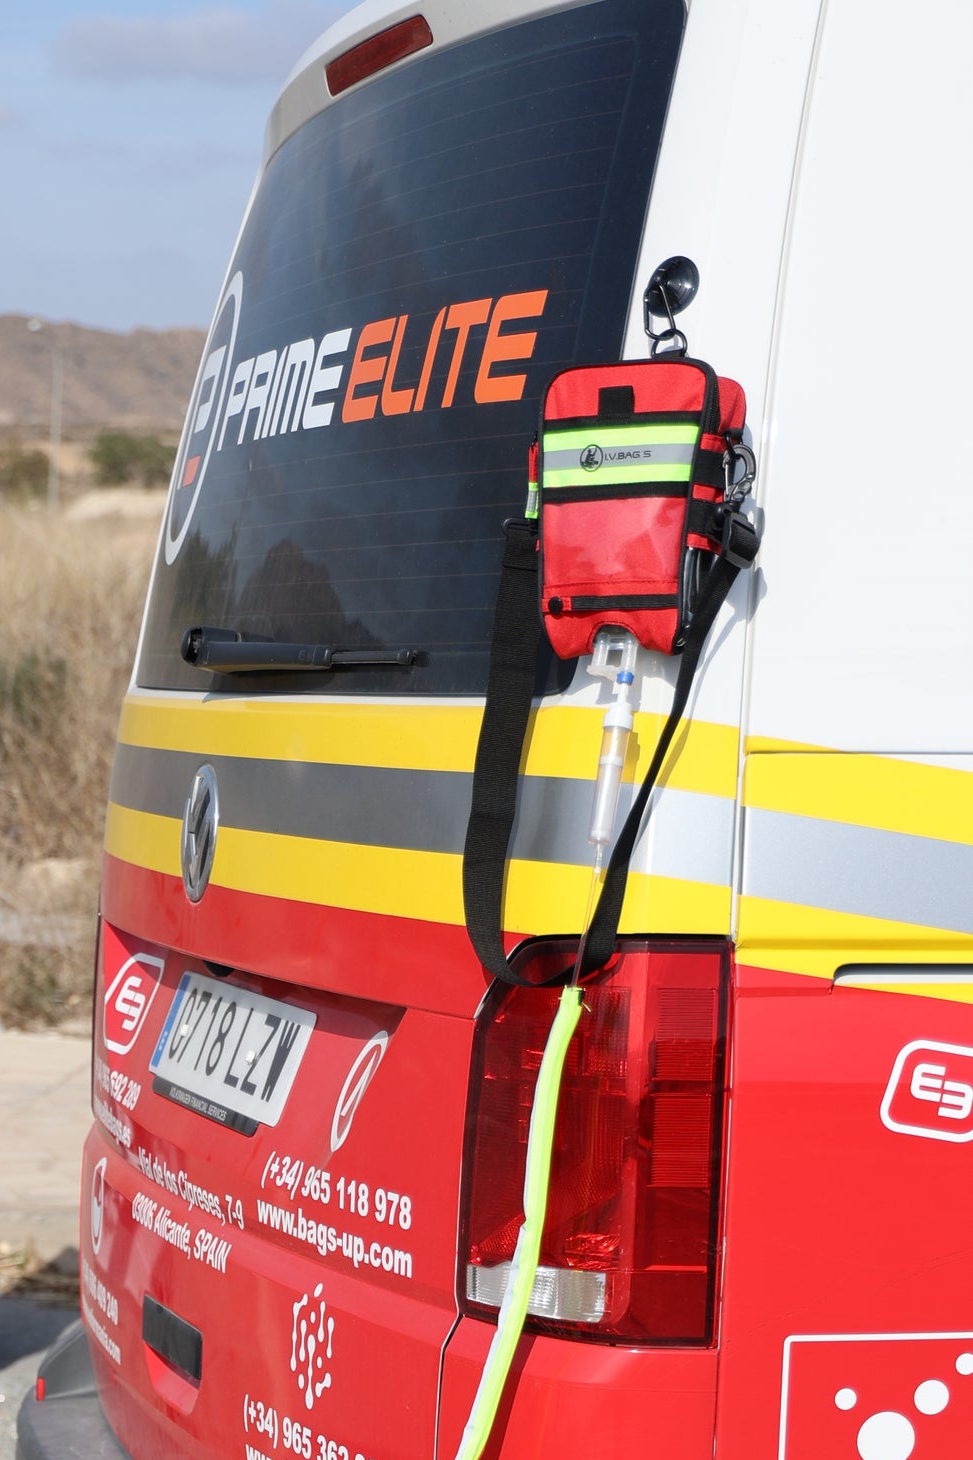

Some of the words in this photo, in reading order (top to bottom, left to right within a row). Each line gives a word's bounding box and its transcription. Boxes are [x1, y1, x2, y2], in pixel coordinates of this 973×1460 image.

[217, 328, 353, 452] PRIME
[341, 289, 549, 424] ELITE
[168, 987, 237, 1077] 0718
[224, 1006, 302, 1103] LZW
[152, 1157, 165, 1187] de
[163, 1161, 179, 1196] los
[178, 1170, 226, 1227] Cipreses,
[224, 1194, 245, 1231] 7-9
[260, 1151, 304, 1200] (+34)
[301, 1165, 331, 1204] 965
[336, 1176, 369, 1217] 118
[374, 1188, 412, 1230] 978
[153, 1206, 192, 1261] Alicante,
[193, 1228, 233, 1274] SPAIN
[257, 1199, 413, 1279] www.bags-up.com
[243, 1393, 279, 1450] (+34)
[282, 1416, 312, 1460] 965
